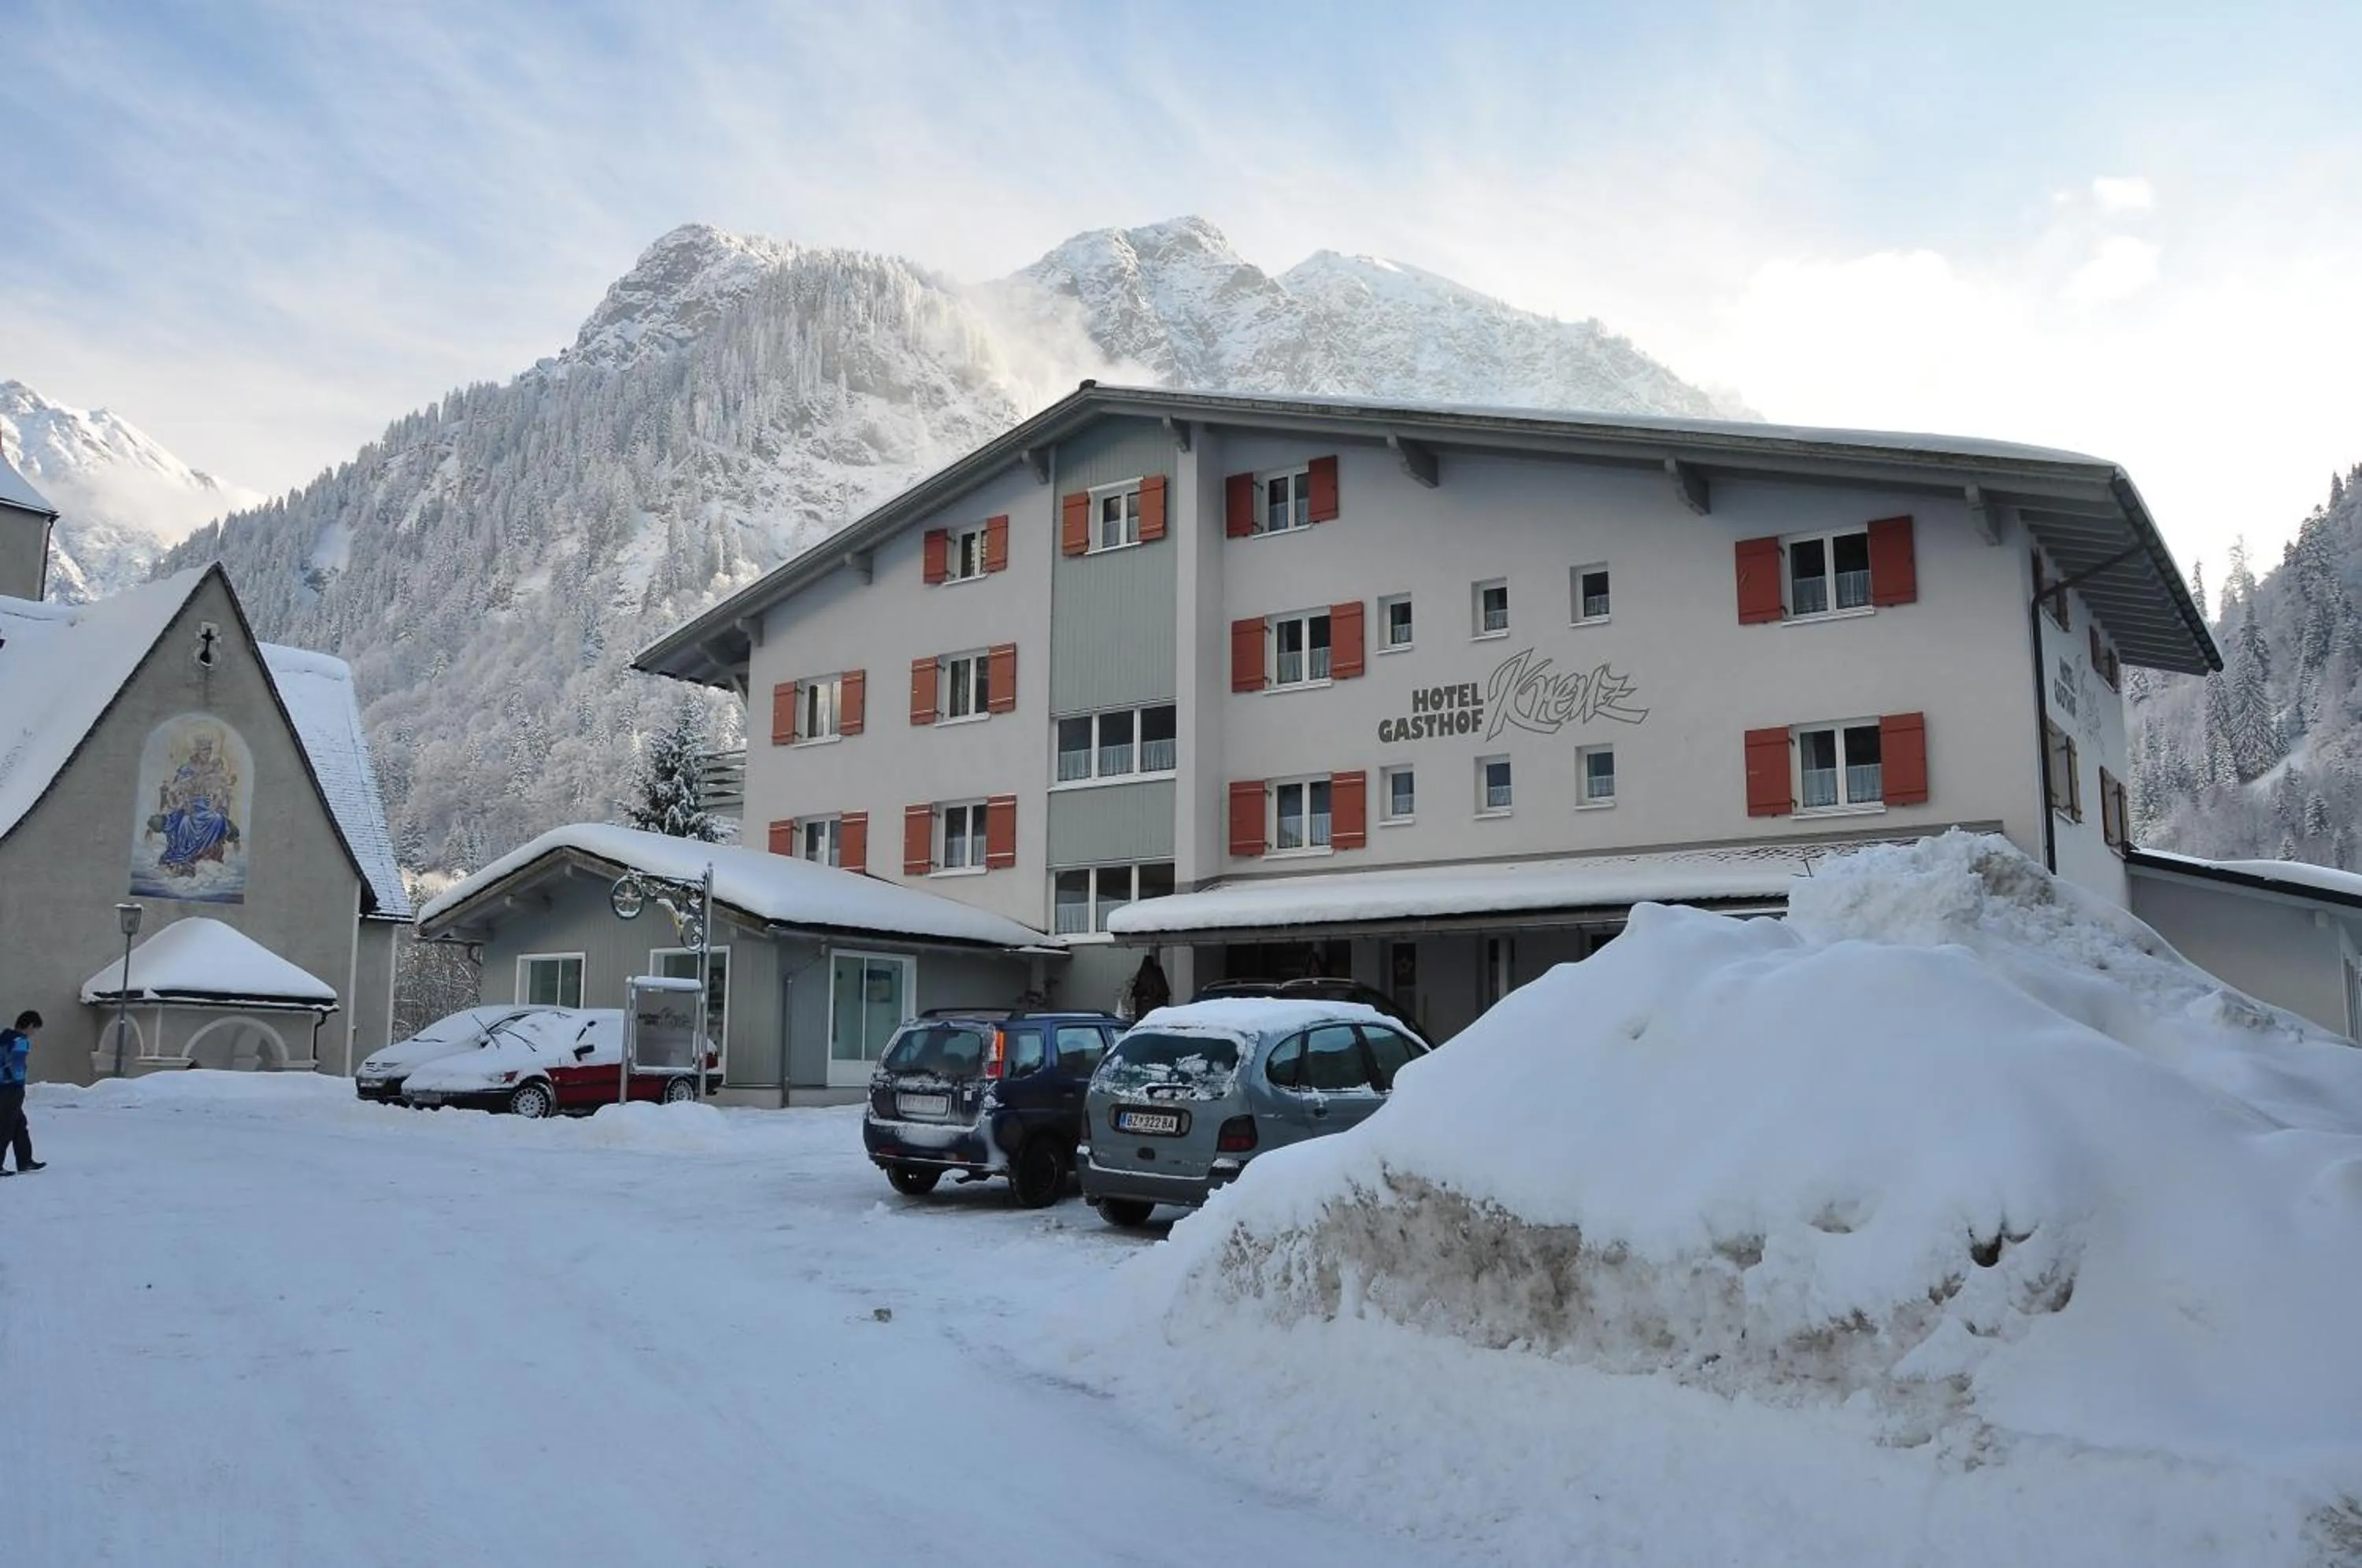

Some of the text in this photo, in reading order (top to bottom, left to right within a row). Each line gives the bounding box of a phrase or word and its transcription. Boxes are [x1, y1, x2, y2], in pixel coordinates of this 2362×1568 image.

[1412, 682, 1484, 713] HOTEL
[1486, 647, 1650, 742] Kreuz
[1378, 708, 1484, 743] GASTHOF
